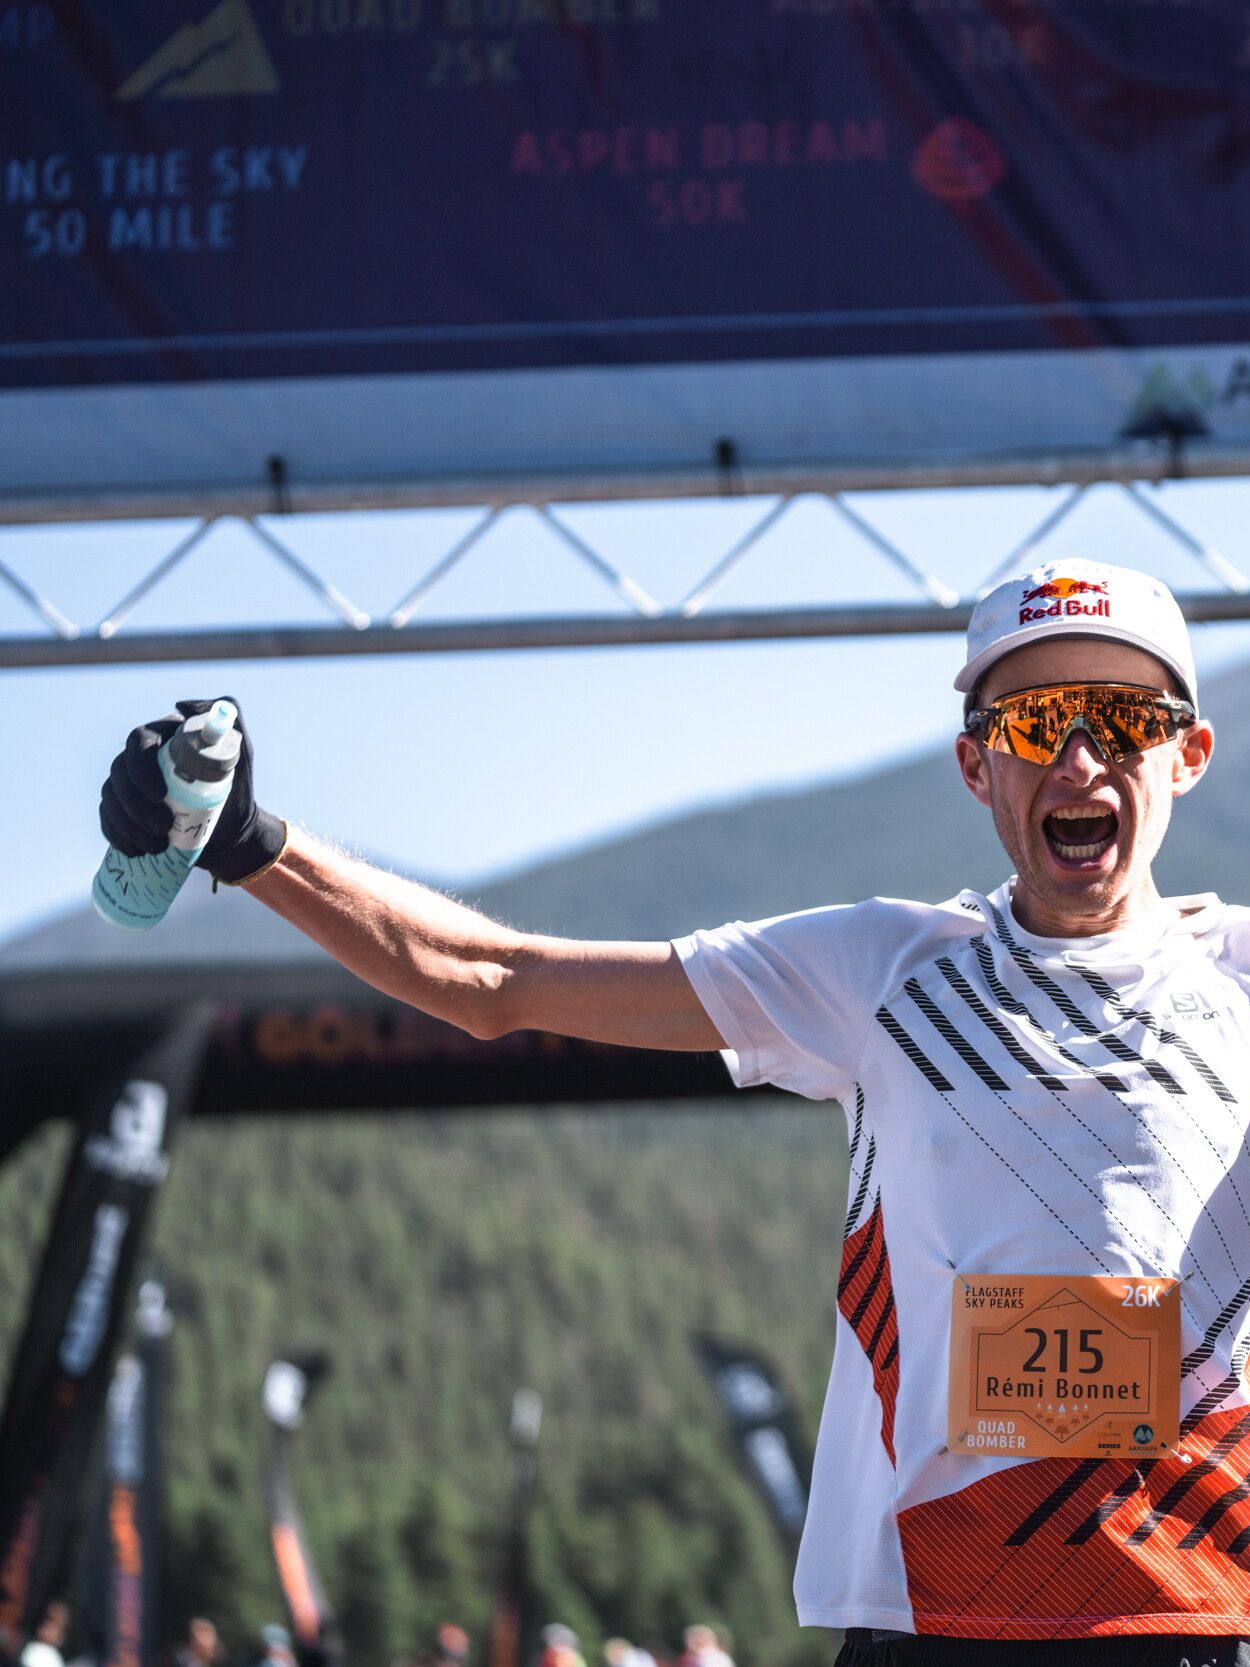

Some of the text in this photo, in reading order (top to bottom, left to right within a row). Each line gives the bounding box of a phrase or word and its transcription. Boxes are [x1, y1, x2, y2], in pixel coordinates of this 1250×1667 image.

[510, 117, 889, 177] ASPEN DREAM
[100, 150, 189, 199] THE
[211, 146, 308, 197] SKY
[24, 202, 236, 257] 50 MILE
[1019, 599, 1110, 625] Red Bull
[965, 1286, 1025, 1298] FLAGSTAFF
[965, 1298, 1025, 1309] SKY PEAKS
[1121, 1284, 1161, 1308] 26K
[1022, 1327, 1104, 1374] 215
[986, 1376, 1141, 1400] Rémi Bonnet
[977, 1420, 1016, 1434] QUAD
[966, 1434, 1027, 1449] BOMBER
